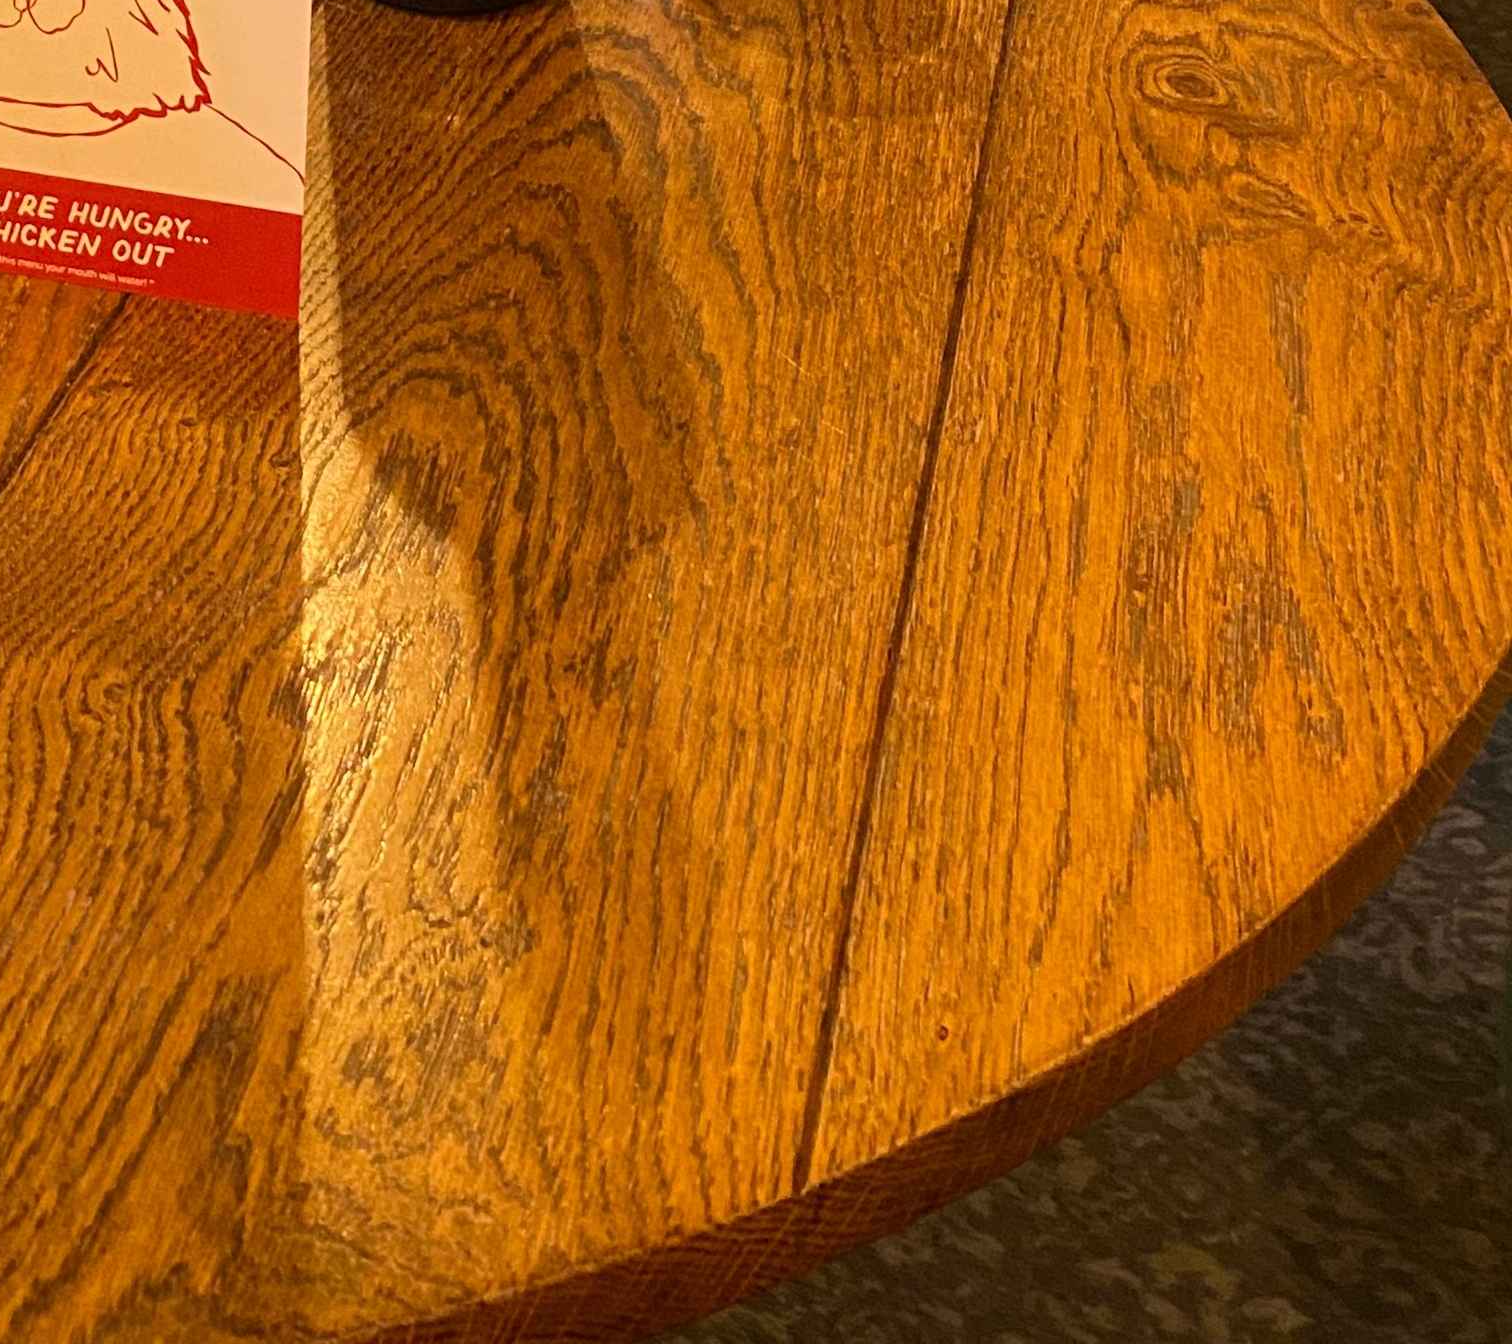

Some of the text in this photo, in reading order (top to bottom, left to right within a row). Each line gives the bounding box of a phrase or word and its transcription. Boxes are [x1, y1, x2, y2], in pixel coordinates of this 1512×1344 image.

[68, 201, 209, 245] HUNGRY...
[112, 239, 175, 268] OUT
[44, 263, 67, 274] your
